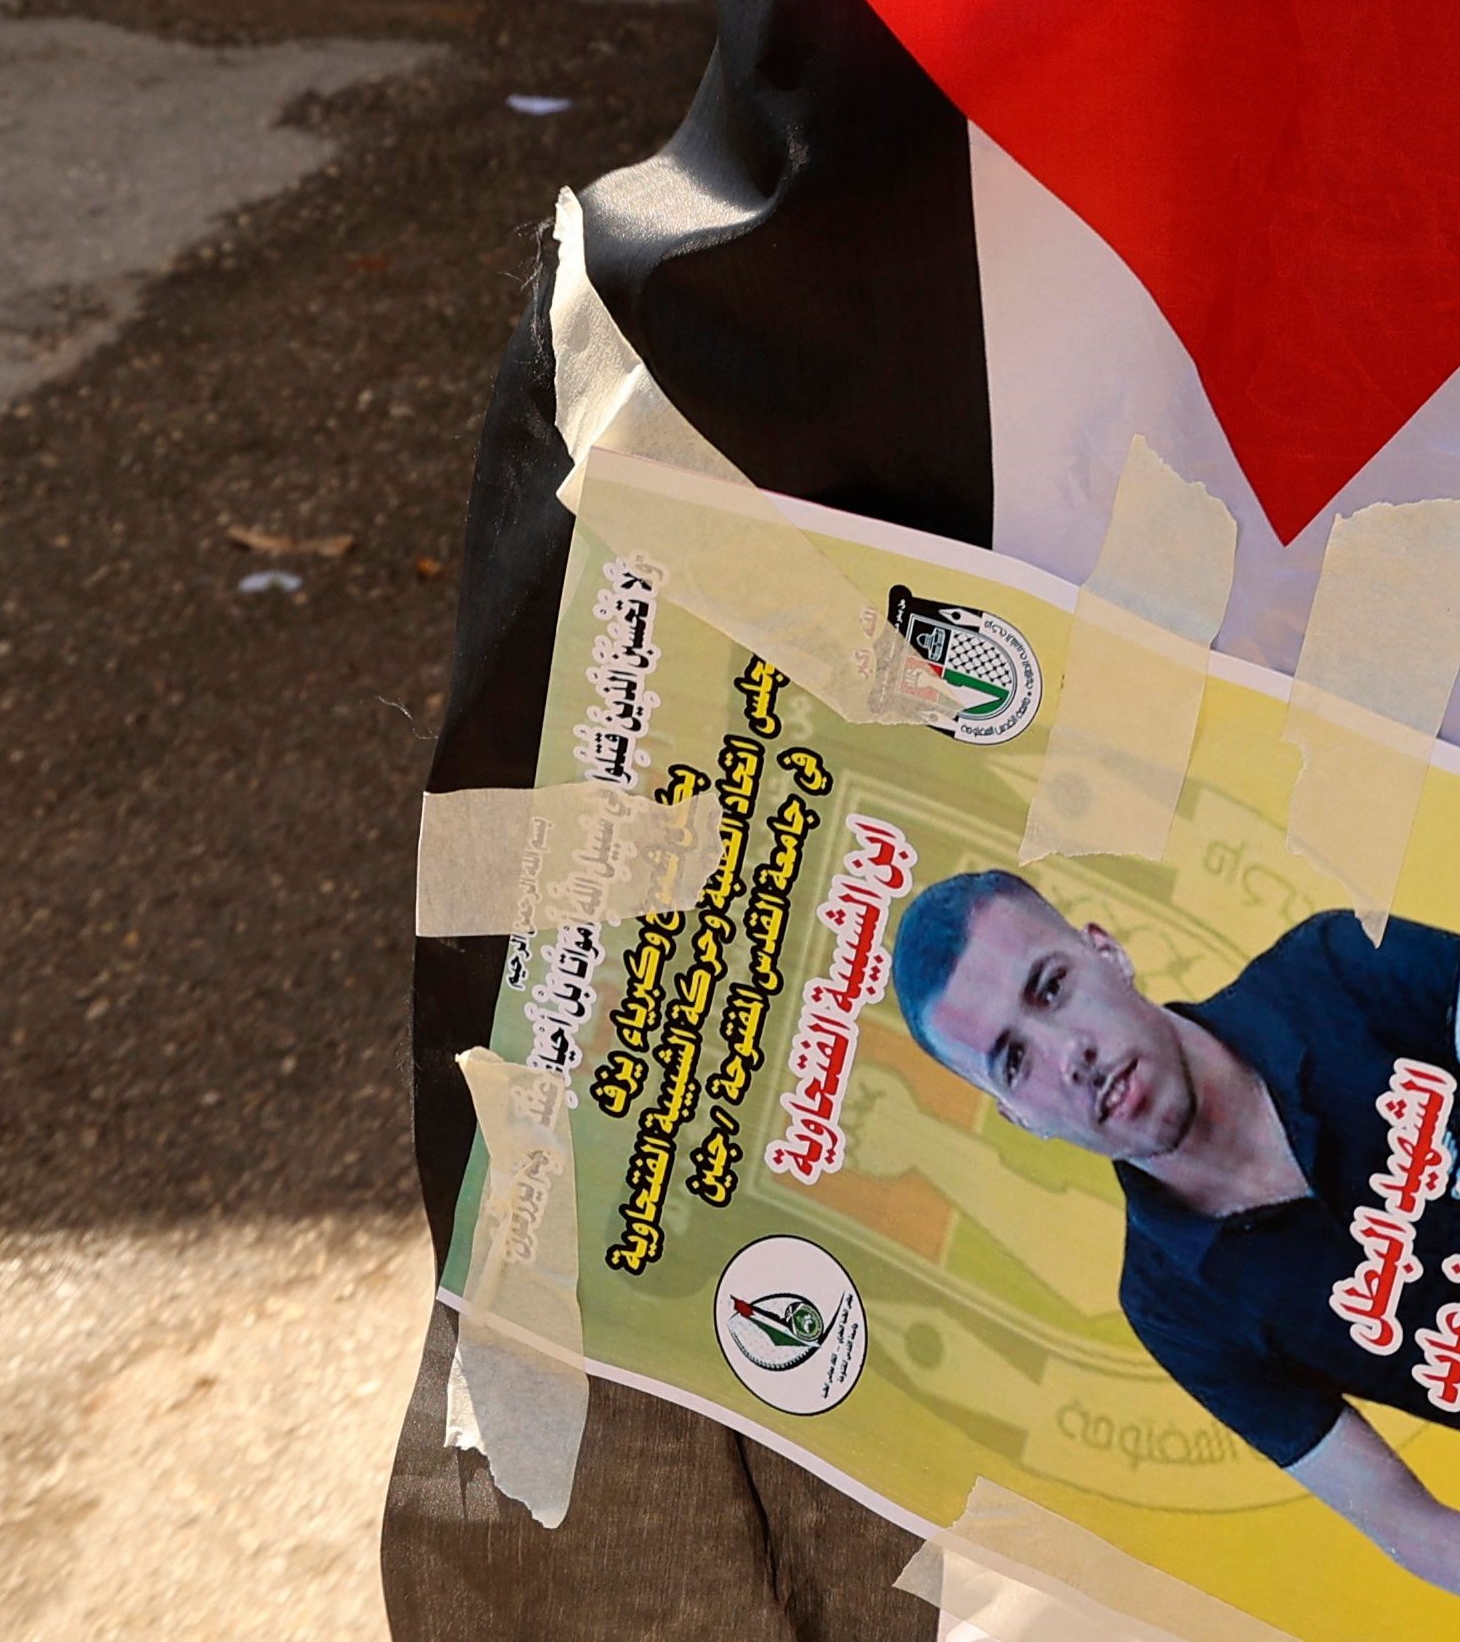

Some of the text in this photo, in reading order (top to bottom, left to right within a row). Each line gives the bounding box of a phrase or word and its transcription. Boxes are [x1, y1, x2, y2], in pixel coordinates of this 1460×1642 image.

[742, 659, 778, 737] جلس
[723, 737, 760, 816] اتحاد
[787, 749, 827, 793] في
[757, 798, 806, 891] جامعة
[506, 931, 537, 990] الرحيم
[617, 928, 672, 1048] وكبرياء
[669, 911, 733, 1026] وحركة
[754, 891, 786, 992] القدس
[709, 986, 765, 1101] المفتوحة
[770, 820, 910, 1178] ابن الشبيبة الفتحاوية
[600, 1052, 645, 1115] يزف
[650, 1025, 698, 1134] الشبيبة
[609, 1134, 672, 1270] الفتحاوية
[701, 1132, 730, 1203] جنين
[1340, 1065, 1447, 1349] الشهيد البطل
